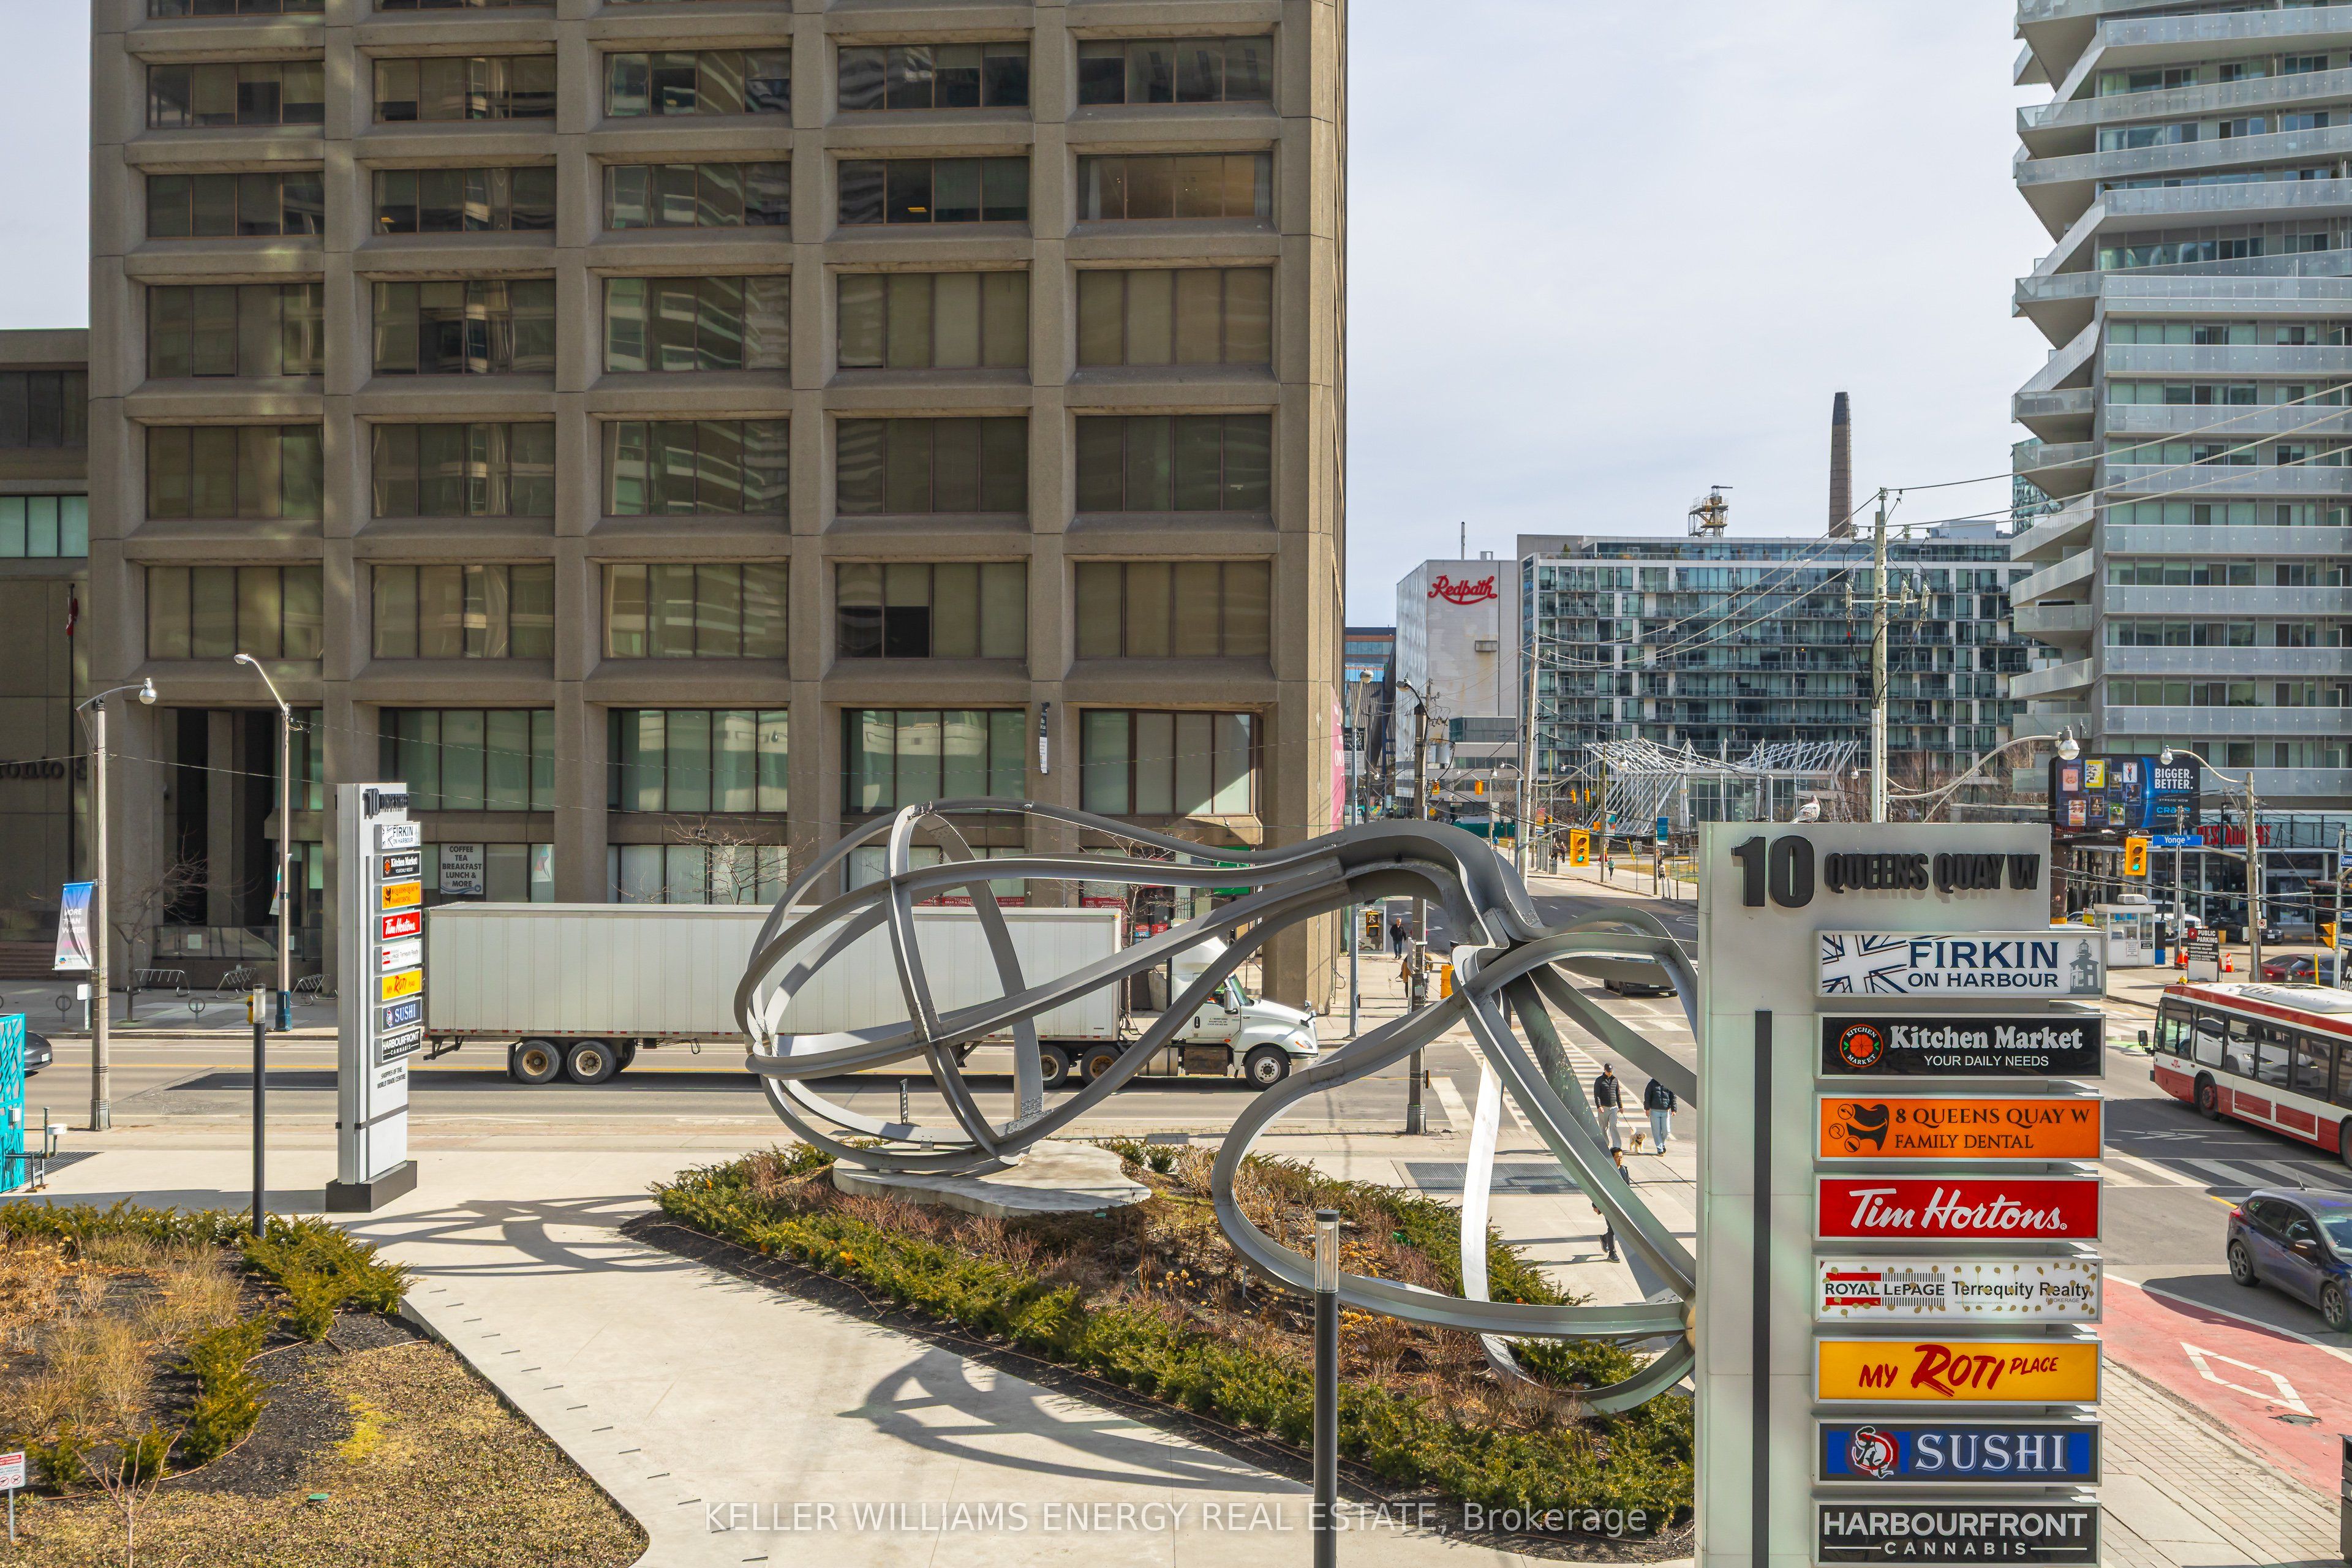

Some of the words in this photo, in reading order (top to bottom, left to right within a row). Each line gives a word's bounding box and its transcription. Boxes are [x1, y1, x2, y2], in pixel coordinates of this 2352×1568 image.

[1428, 575, 1498, 605] Redpath
[2155, 767, 2193, 779] BIGGER.
[2155, 778, 2193, 790] BETTER.
[393, 826, 413, 838] FIRKIN
[2164, 836, 2185, 845] Yonge
[1731, 835, 1814, 908] 10
[1824, 853, 1929, 894] QUEENS
[1933, 853, 2006, 894] QUAY
[2007, 853, 2041, 891] W
[385, 919, 396, 935] Tim
[1908, 941, 2059, 969] FIRKIN
[1907, 973, 1939, 988] ON
[1947, 973, 2059, 988] HARBOUR
[394, 1004, 416, 1022] SUSHI
[382, 1031, 420, 1051] HARBOURFRONT
[1846, 1027, 1877, 1038] KITCHEN
[1890, 1025, 1990, 1049] Kitchen
[1994, 1025, 2082, 1049] Market
[390, 1044, 411, 1055] CANNABIS
[1847, 1054, 1875, 1065] MARKET
[1924, 1055, 1961, 1067] YOUR
[1964, 1055, 2002, 1066] DAILY
[2005, 1055, 2049, 1066] NEEDS
[1895, 1108, 1906, 1125] 8
[1913, 1108, 2000, 1129] QUEENS
[2006, 1108, 2065, 1129] QUAY
[2073, 1108, 2090, 1124] W
[1895, 1134, 1959, 1150] FAMILY
[1964, 1134, 2034, 1150] DENTAL
[1849, 1188, 1916, 1230] Tim
[1825, 1283, 1880, 1296] ROYAL
[1952, 1281, 2034, 1301] Terrequity
[2040, 1282, 2090, 1300] Realty
[1858, 1363, 1898, 1389] MY
[1910, 1344, 2005, 1398] ROTI
[2009, 1356, 2059, 1375] PLACE
[1915, 1433, 2067, 1471] SUSHI
[1824, 1512, 2087, 1536] HARBOURFRONT
[1885, 1542, 2026, 1555] CANNABIS
